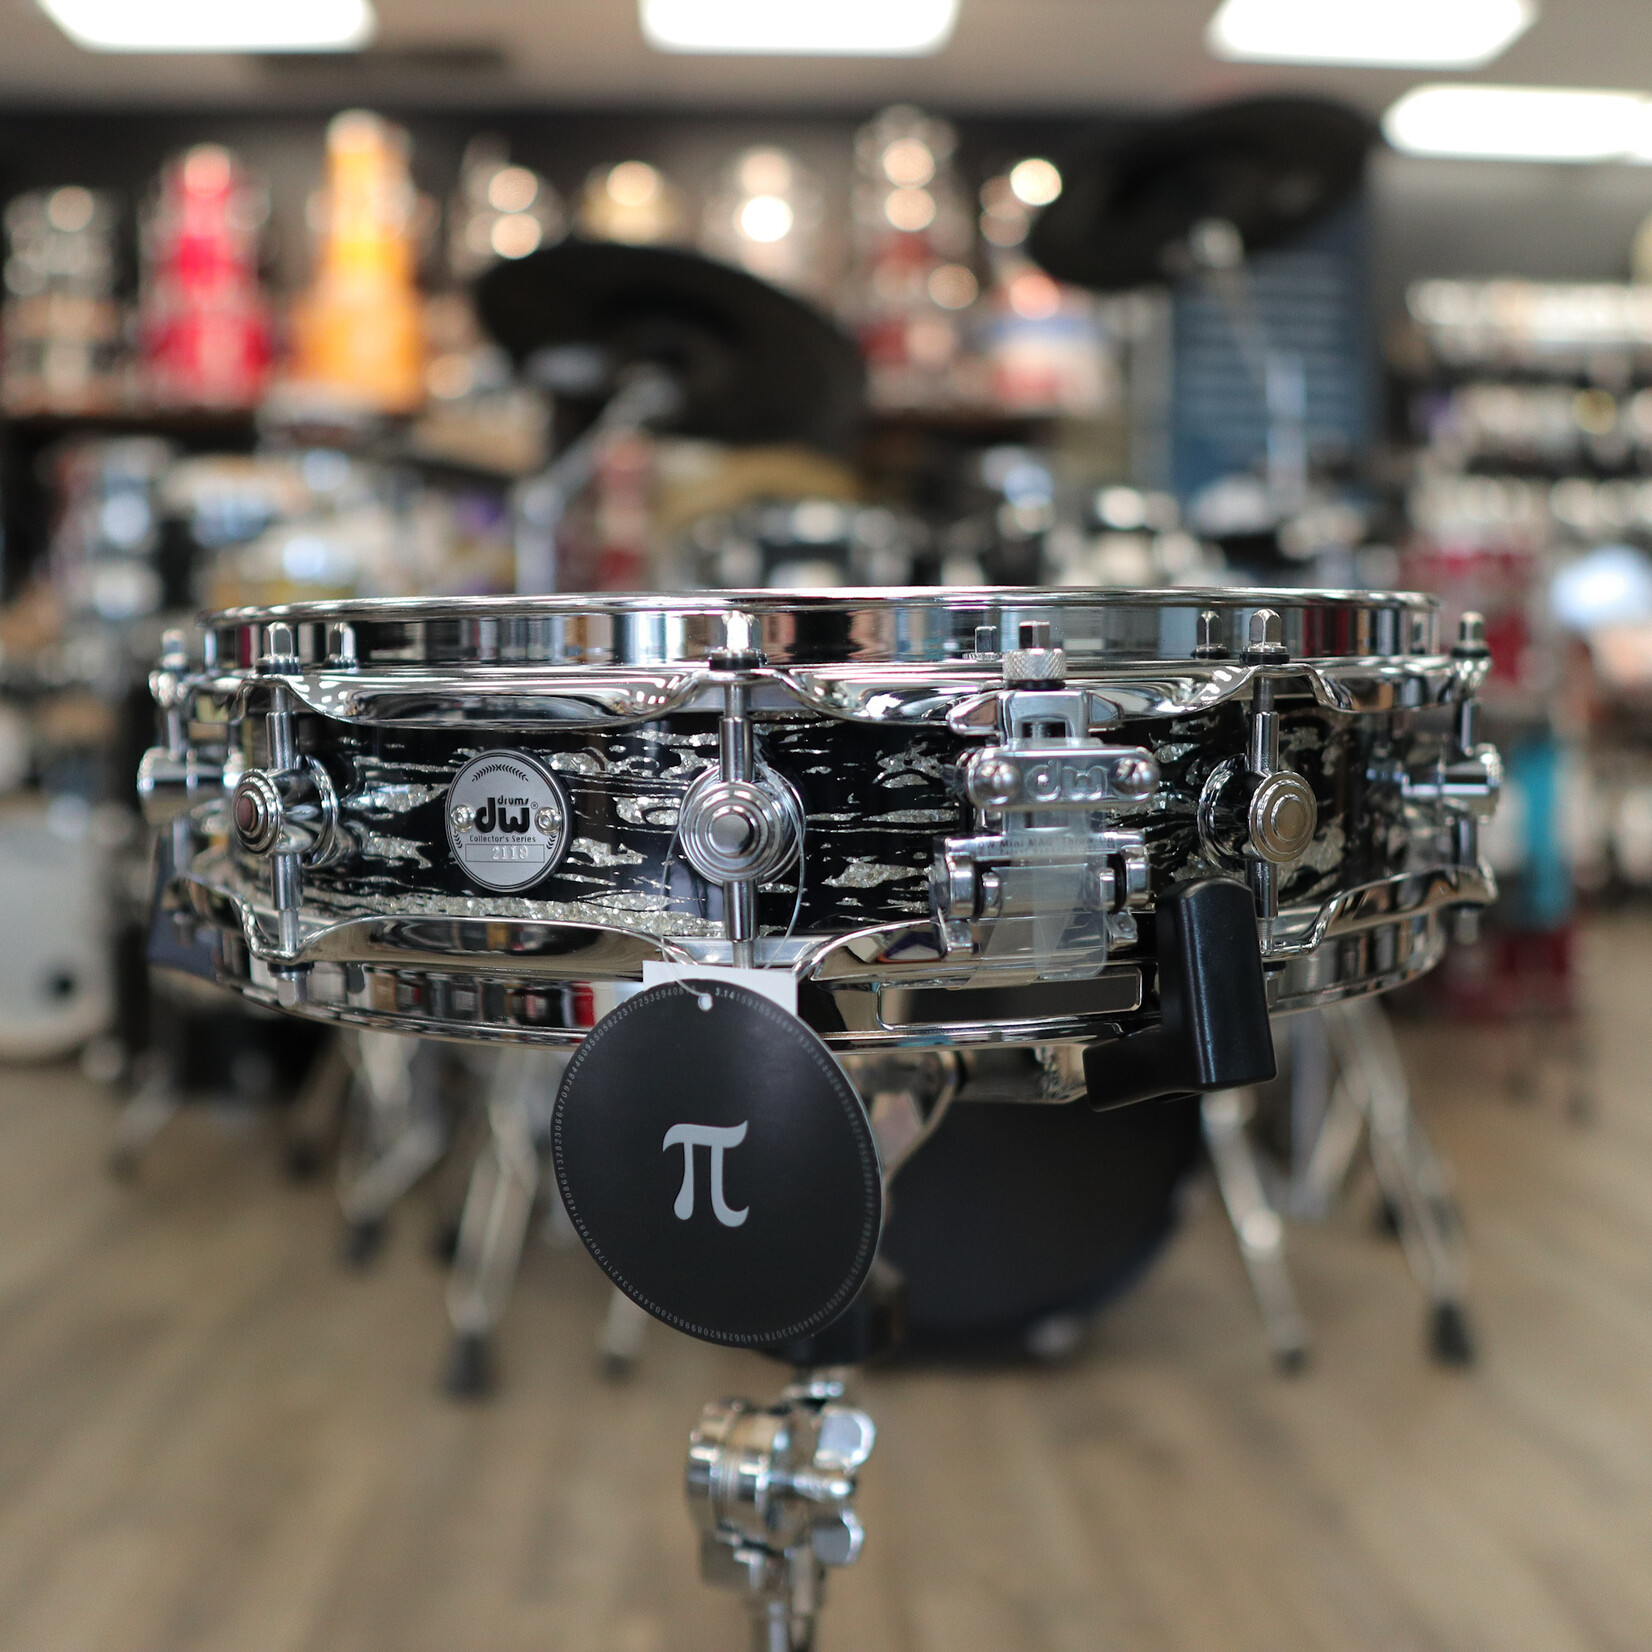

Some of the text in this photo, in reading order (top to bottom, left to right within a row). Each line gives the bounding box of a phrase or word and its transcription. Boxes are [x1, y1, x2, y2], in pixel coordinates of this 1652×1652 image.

[497, 795, 529, 805] drums
[474, 797, 530, 833] dw
[512, 835, 536, 843] Series
